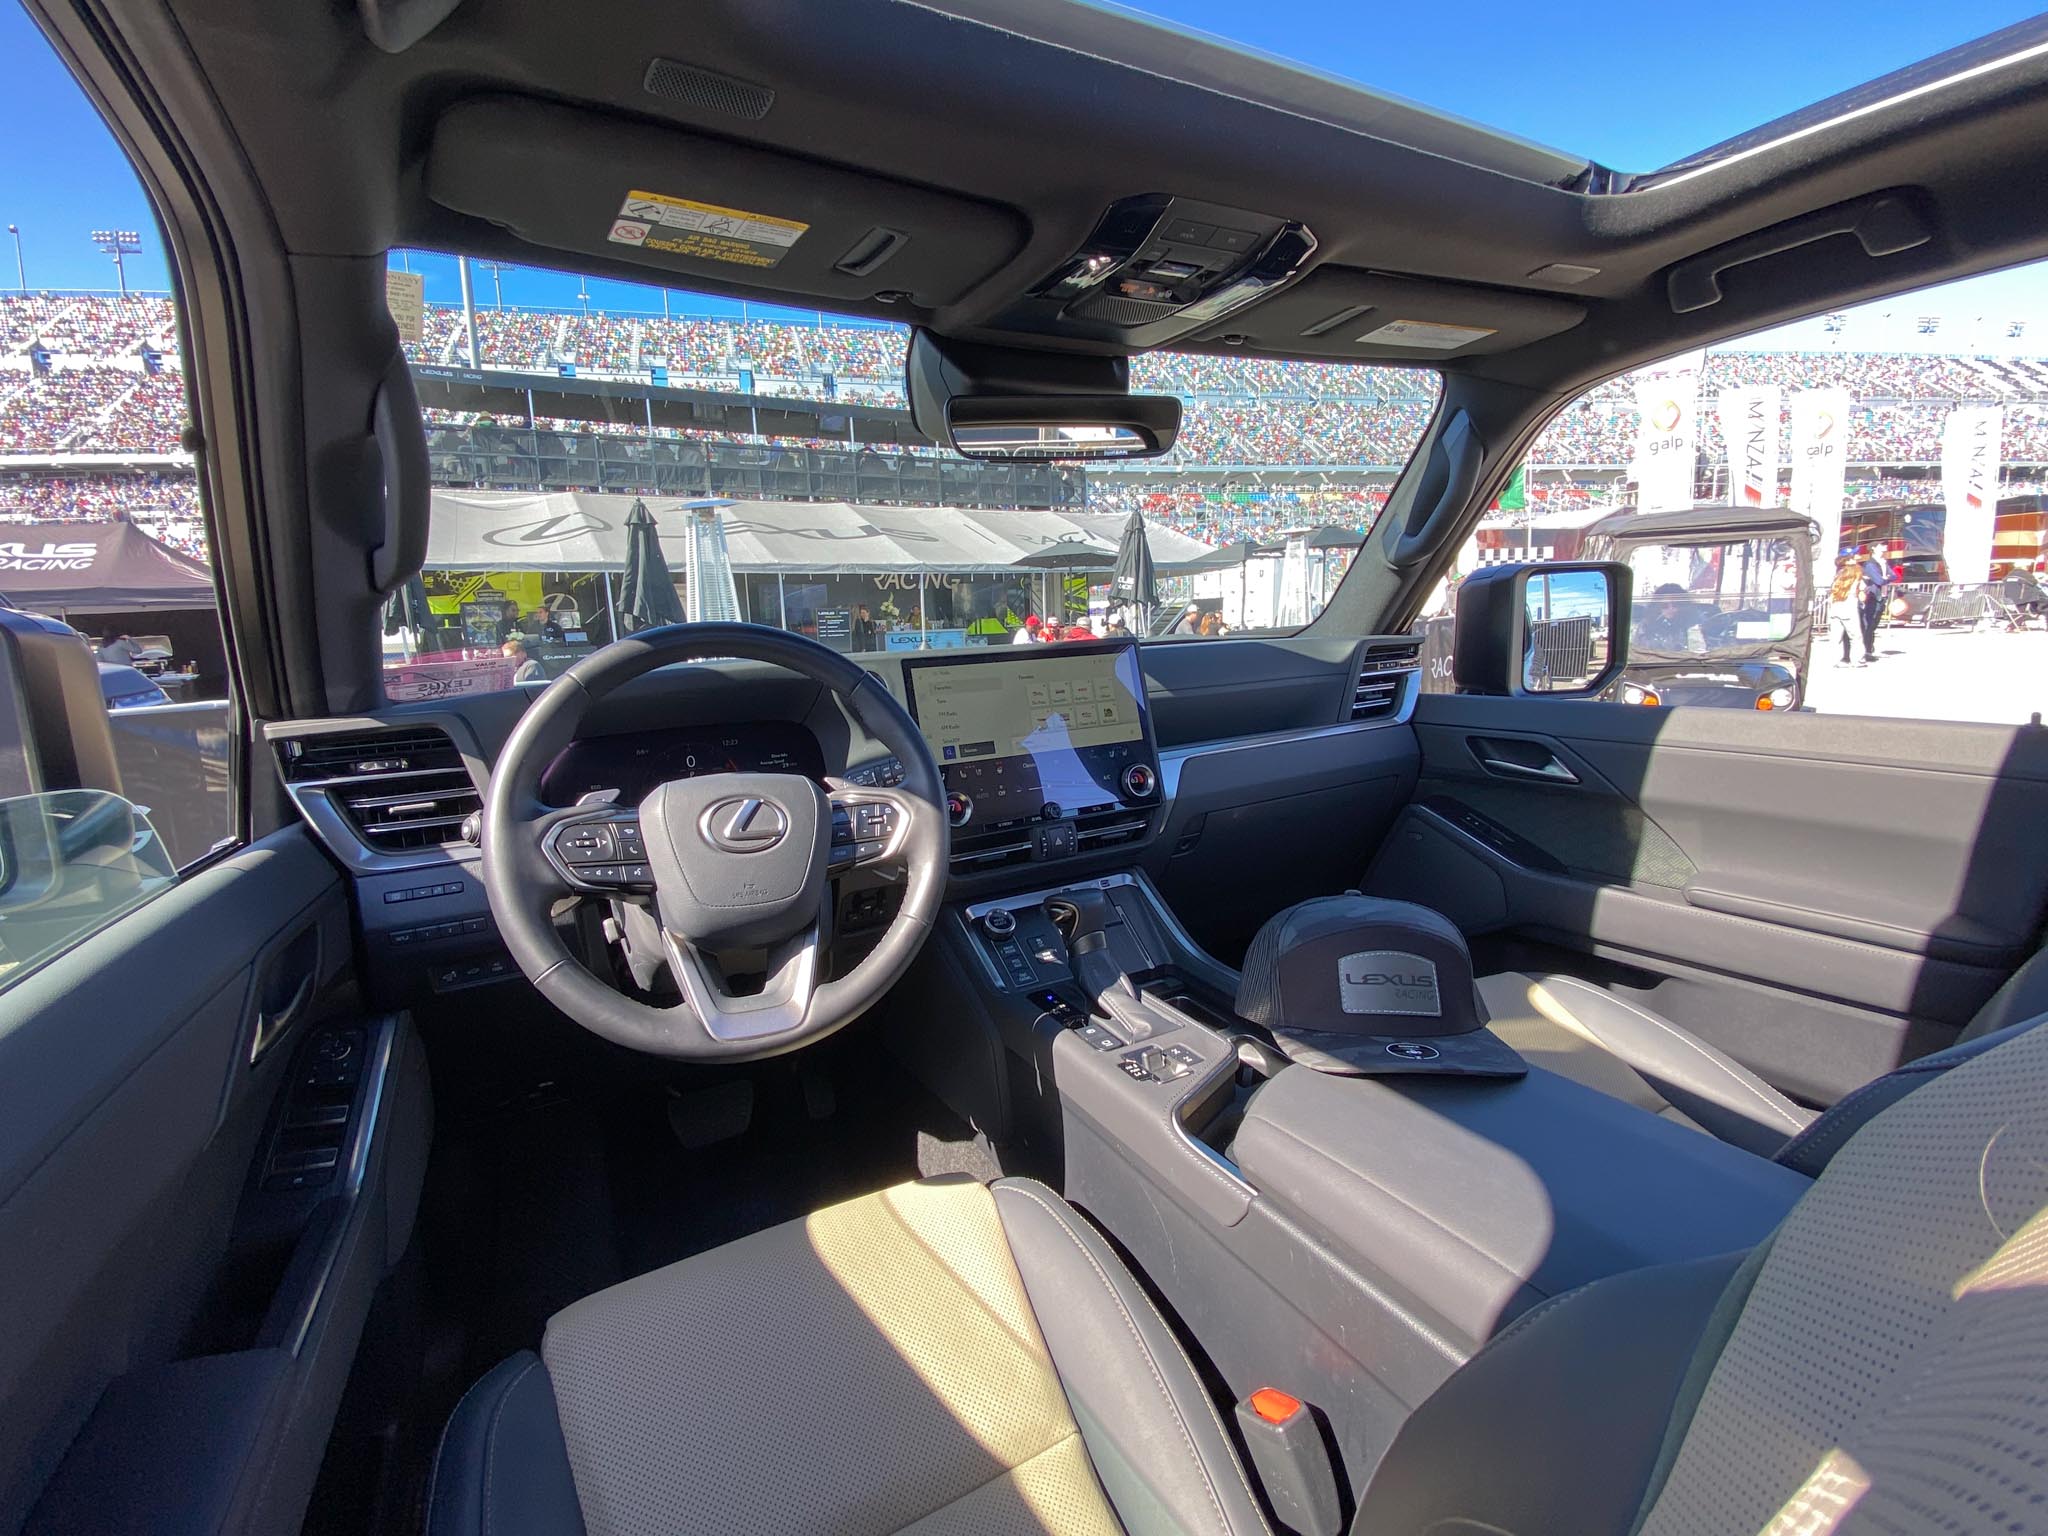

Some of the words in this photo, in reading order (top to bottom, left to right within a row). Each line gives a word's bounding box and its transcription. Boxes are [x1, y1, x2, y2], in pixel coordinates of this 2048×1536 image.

[1649, 435, 1684, 456] galp
[686, 755, 696, 768] 0
[1346, 973, 1433, 987] LEXUS
[1395, 988, 1434, 1001] RACING
